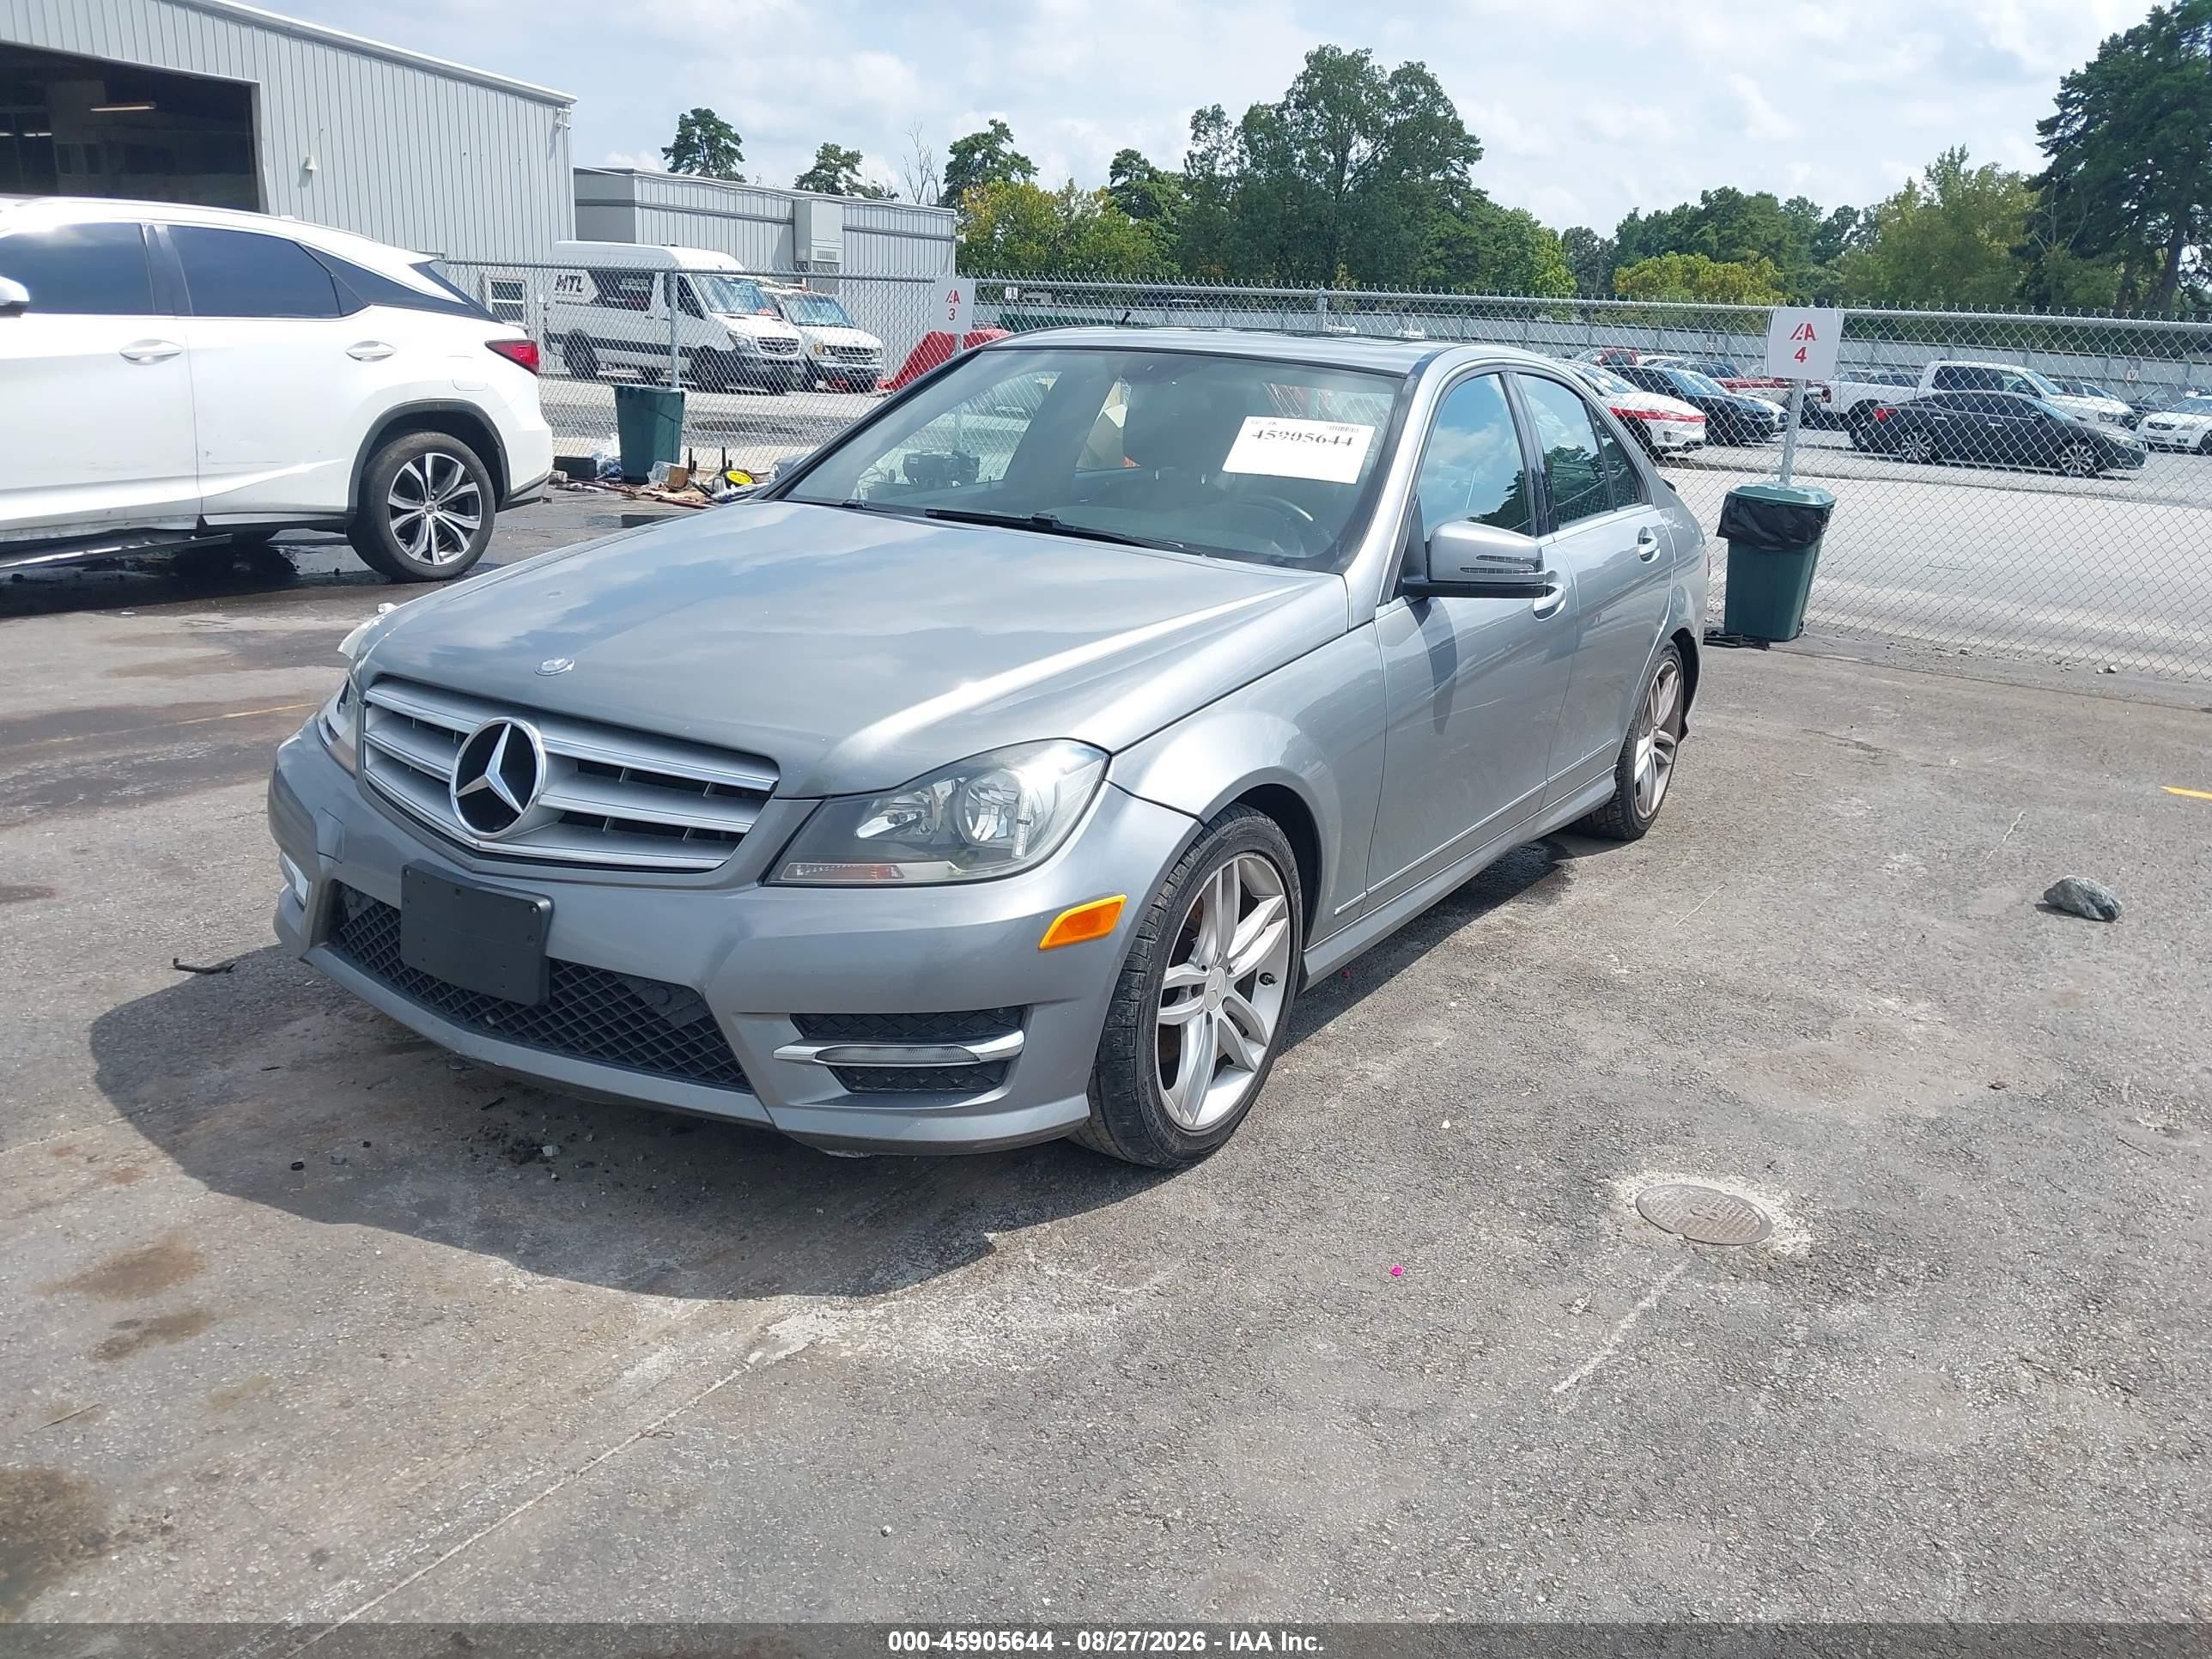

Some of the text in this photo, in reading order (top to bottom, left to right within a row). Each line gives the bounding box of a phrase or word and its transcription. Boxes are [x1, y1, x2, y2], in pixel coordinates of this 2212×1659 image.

[555, 275, 583, 292] MTL
[948, 307, 956, 321] 3
[1794, 346, 1807, 363] 4
[1251, 429, 1353, 447] 45905644
